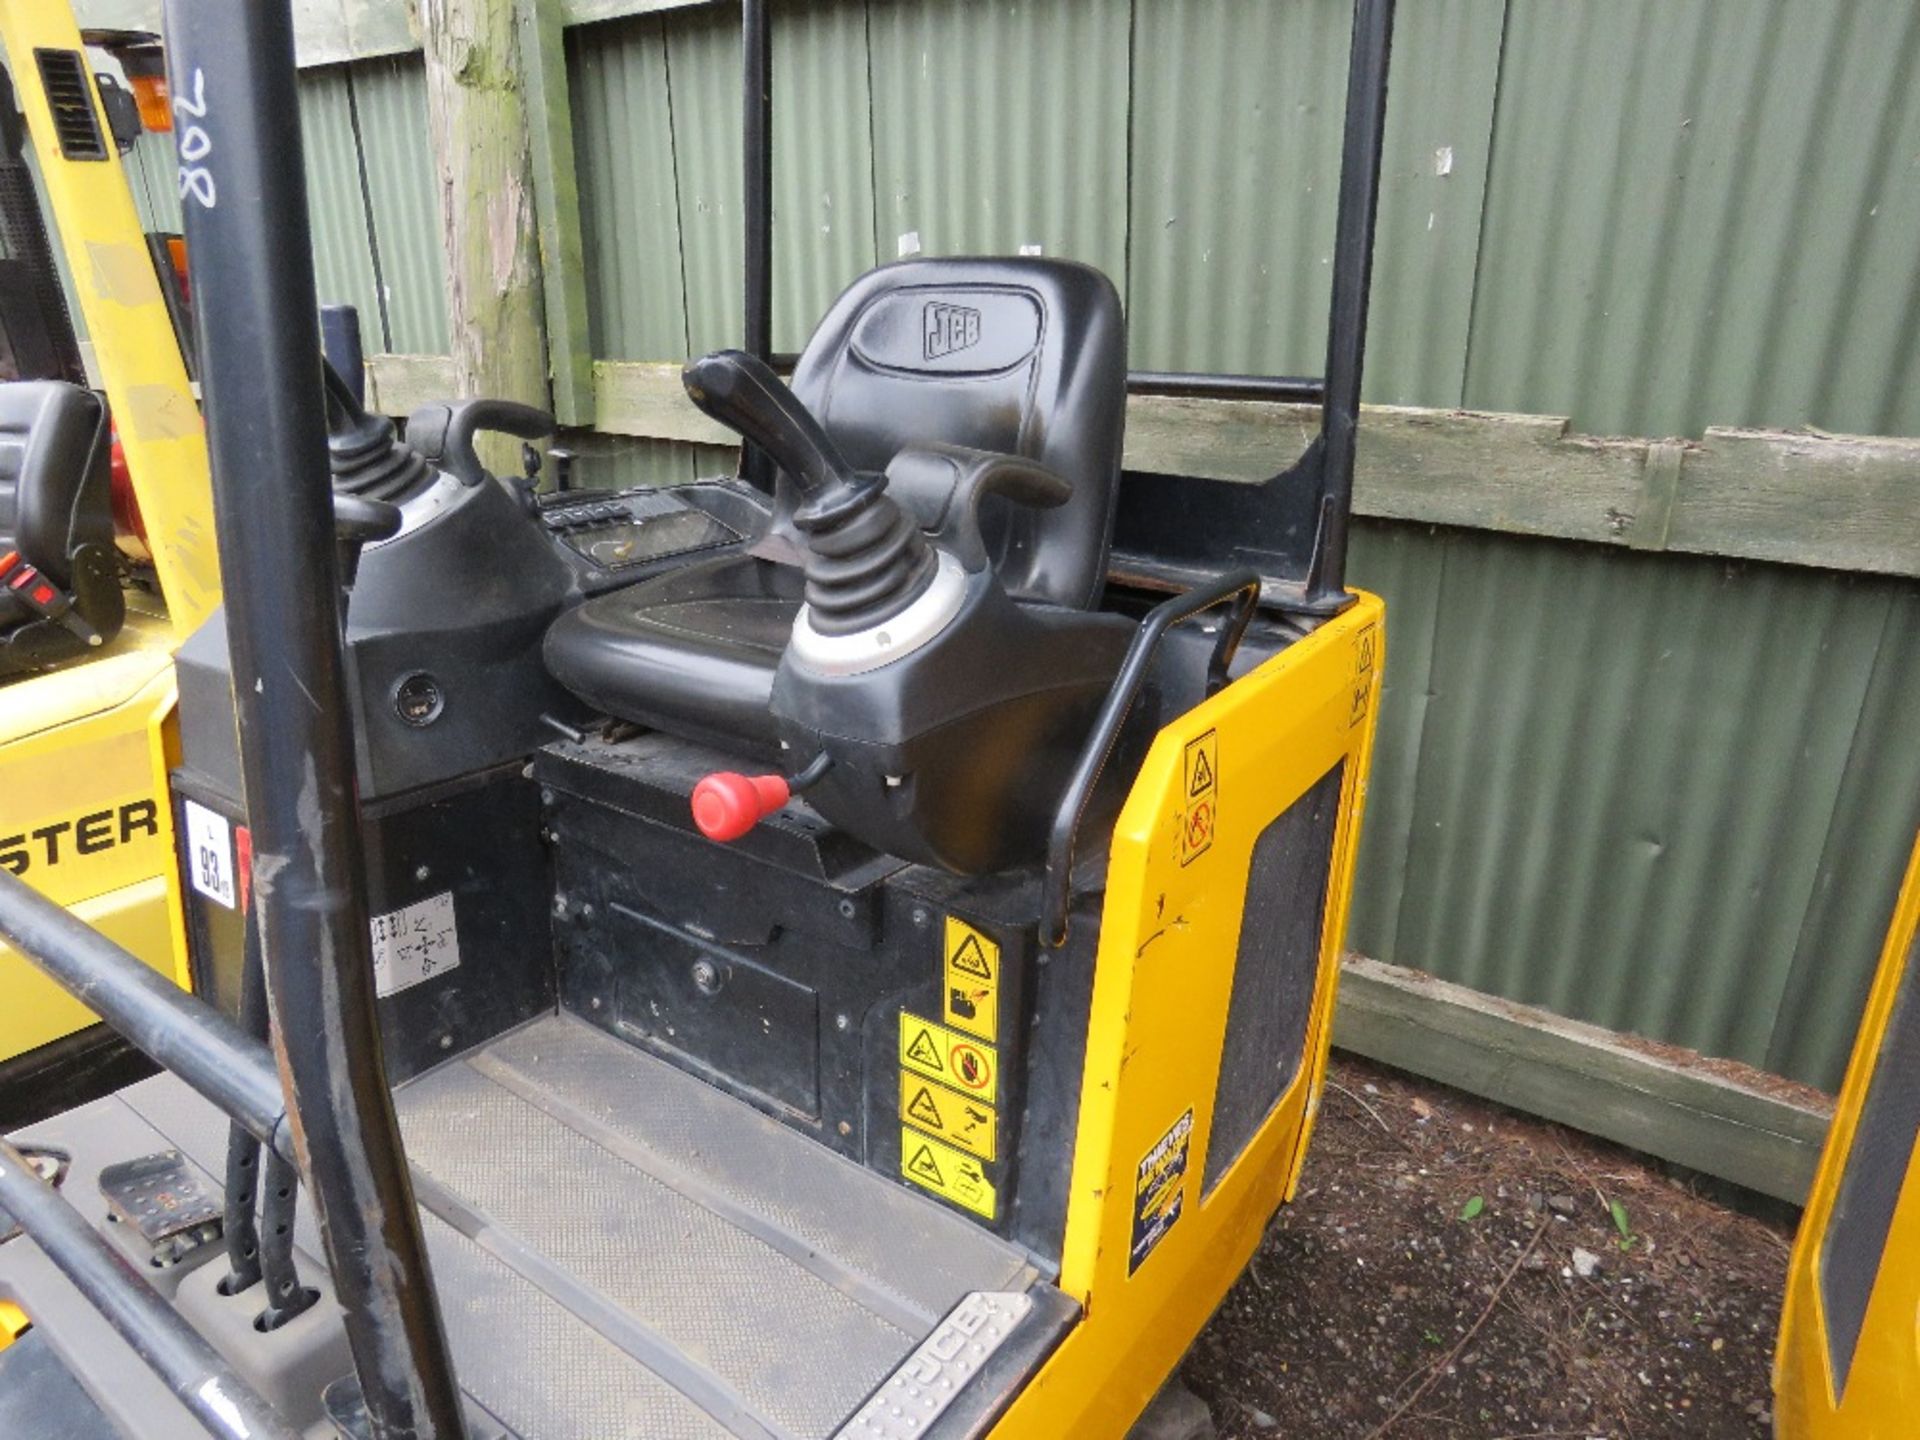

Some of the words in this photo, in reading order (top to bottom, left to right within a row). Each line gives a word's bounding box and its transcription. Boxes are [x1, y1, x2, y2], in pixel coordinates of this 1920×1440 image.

[927, 304, 981, 358] JCB
[0, 798, 158, 877] STER
[199, 845, 221, 894] 93
[909, 1308, 988, 1386] JCB
